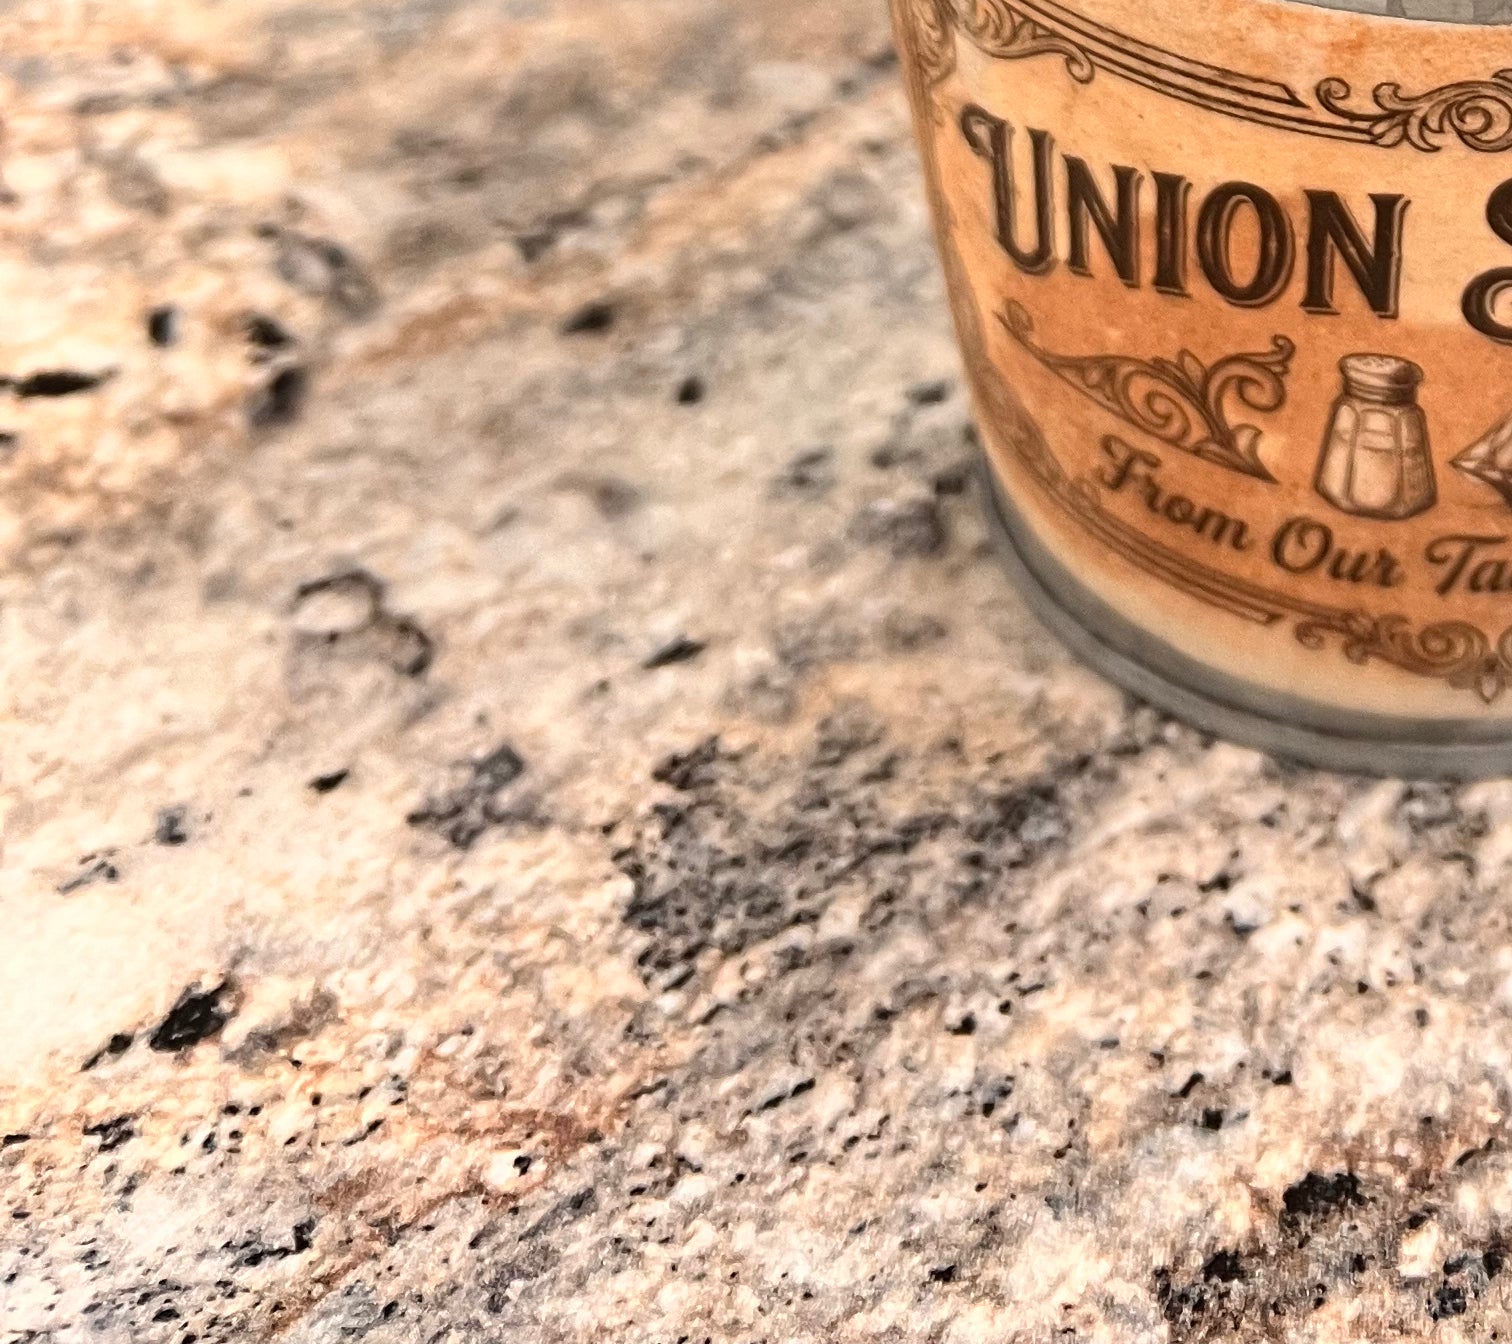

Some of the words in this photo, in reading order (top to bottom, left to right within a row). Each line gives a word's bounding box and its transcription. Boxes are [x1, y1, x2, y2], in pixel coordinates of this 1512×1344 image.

[960, 103, 1411, 319] UNION
[1098, 433, 1252, 551] From
[1270, 516, 1403, 588] Our
